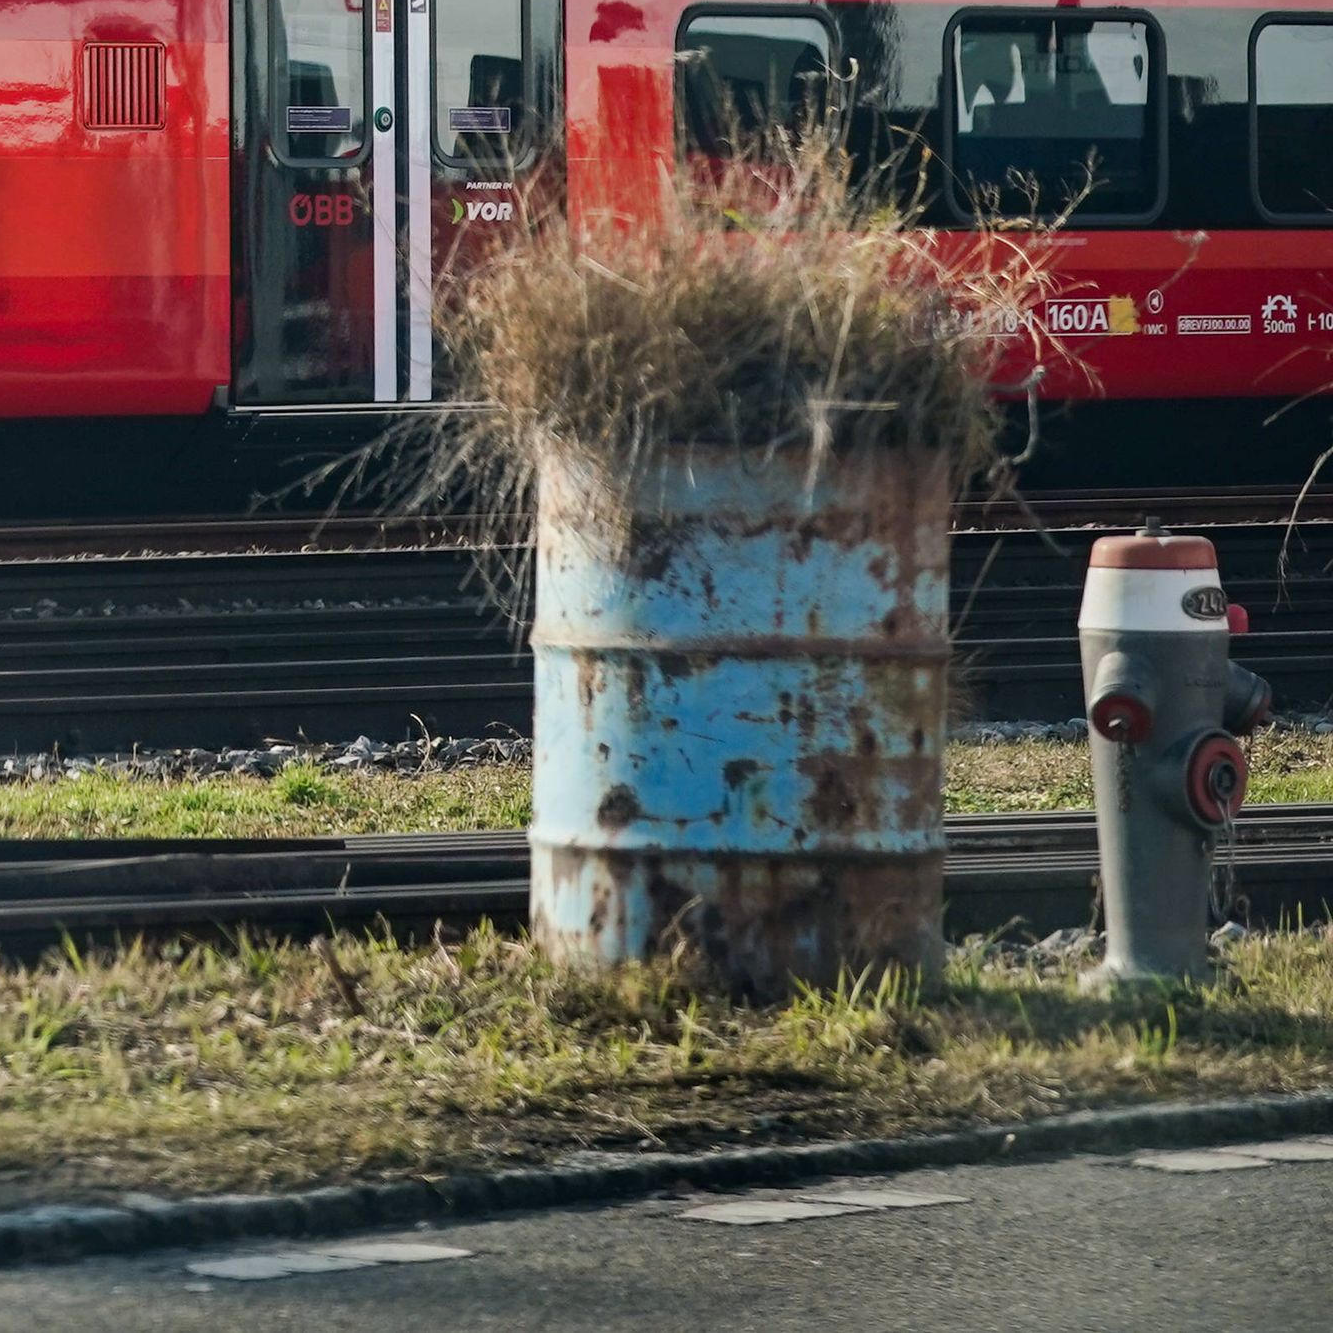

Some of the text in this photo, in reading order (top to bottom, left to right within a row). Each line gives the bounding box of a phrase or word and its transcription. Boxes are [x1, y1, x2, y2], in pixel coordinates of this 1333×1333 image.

[466, 181, 503, 190] PARTNER
[290, 192, 354, 227] ÖBB
[466, 202, 513, 222] VOR
[1263, 319, 1296, 334] 500m
